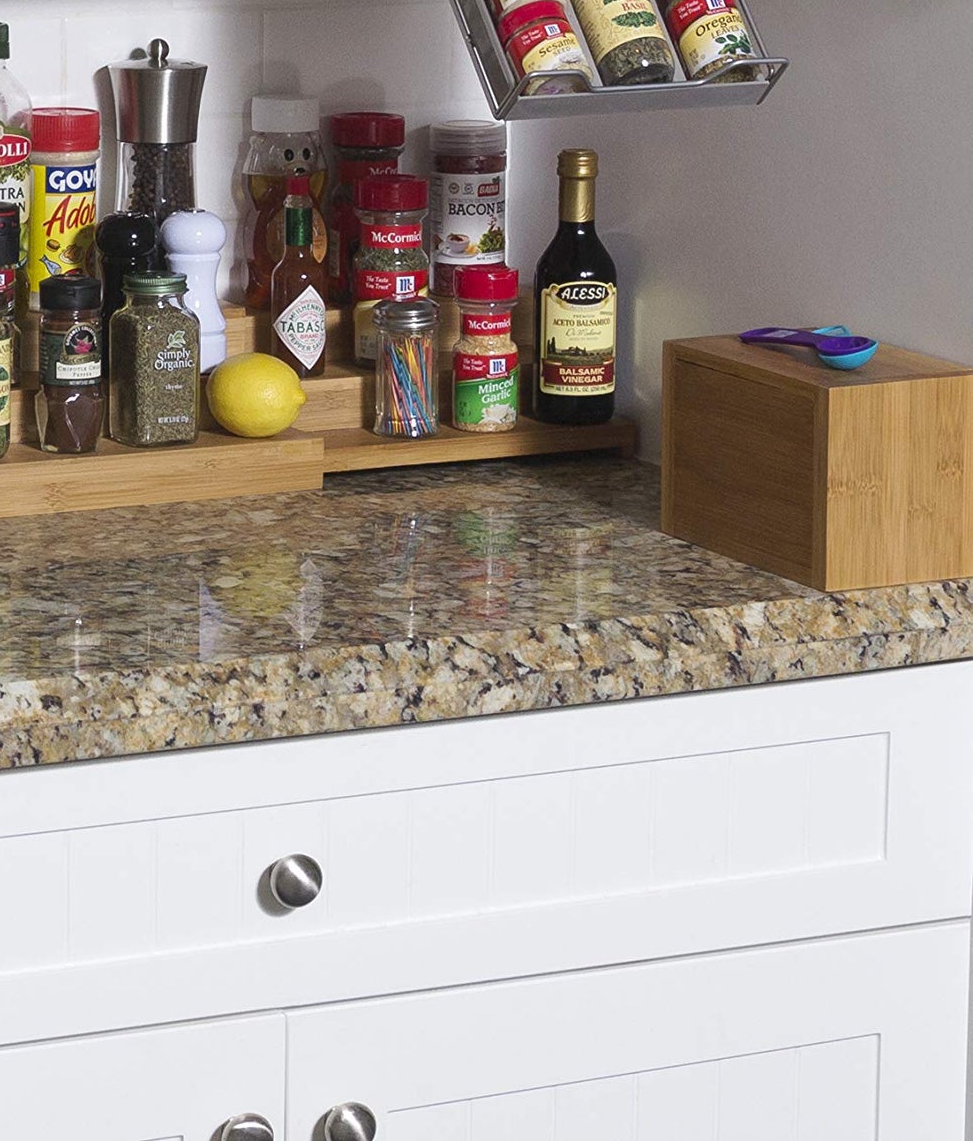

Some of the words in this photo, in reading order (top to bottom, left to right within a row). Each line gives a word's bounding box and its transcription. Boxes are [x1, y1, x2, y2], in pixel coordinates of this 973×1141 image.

[621, 2, 646, 12] BASIL
[538, 37, 576, 58] Sesame
[448, 202, 495, 216] BACON
[561, 287, 606, 300] ALESSI
[553, 319, 575, 327] ACETO
[577, 318, 611, 327] BALSAMICO
[157, 347, 191, 361] Simply
[154, 359, 193, 372] Organic
[559, 367, 605, 375] BALSAMIC
[478, 376, 514, 395] Minced
[561, 375, 603, 383] VINEGAR
[481, 389, 511, 404] Garlic
